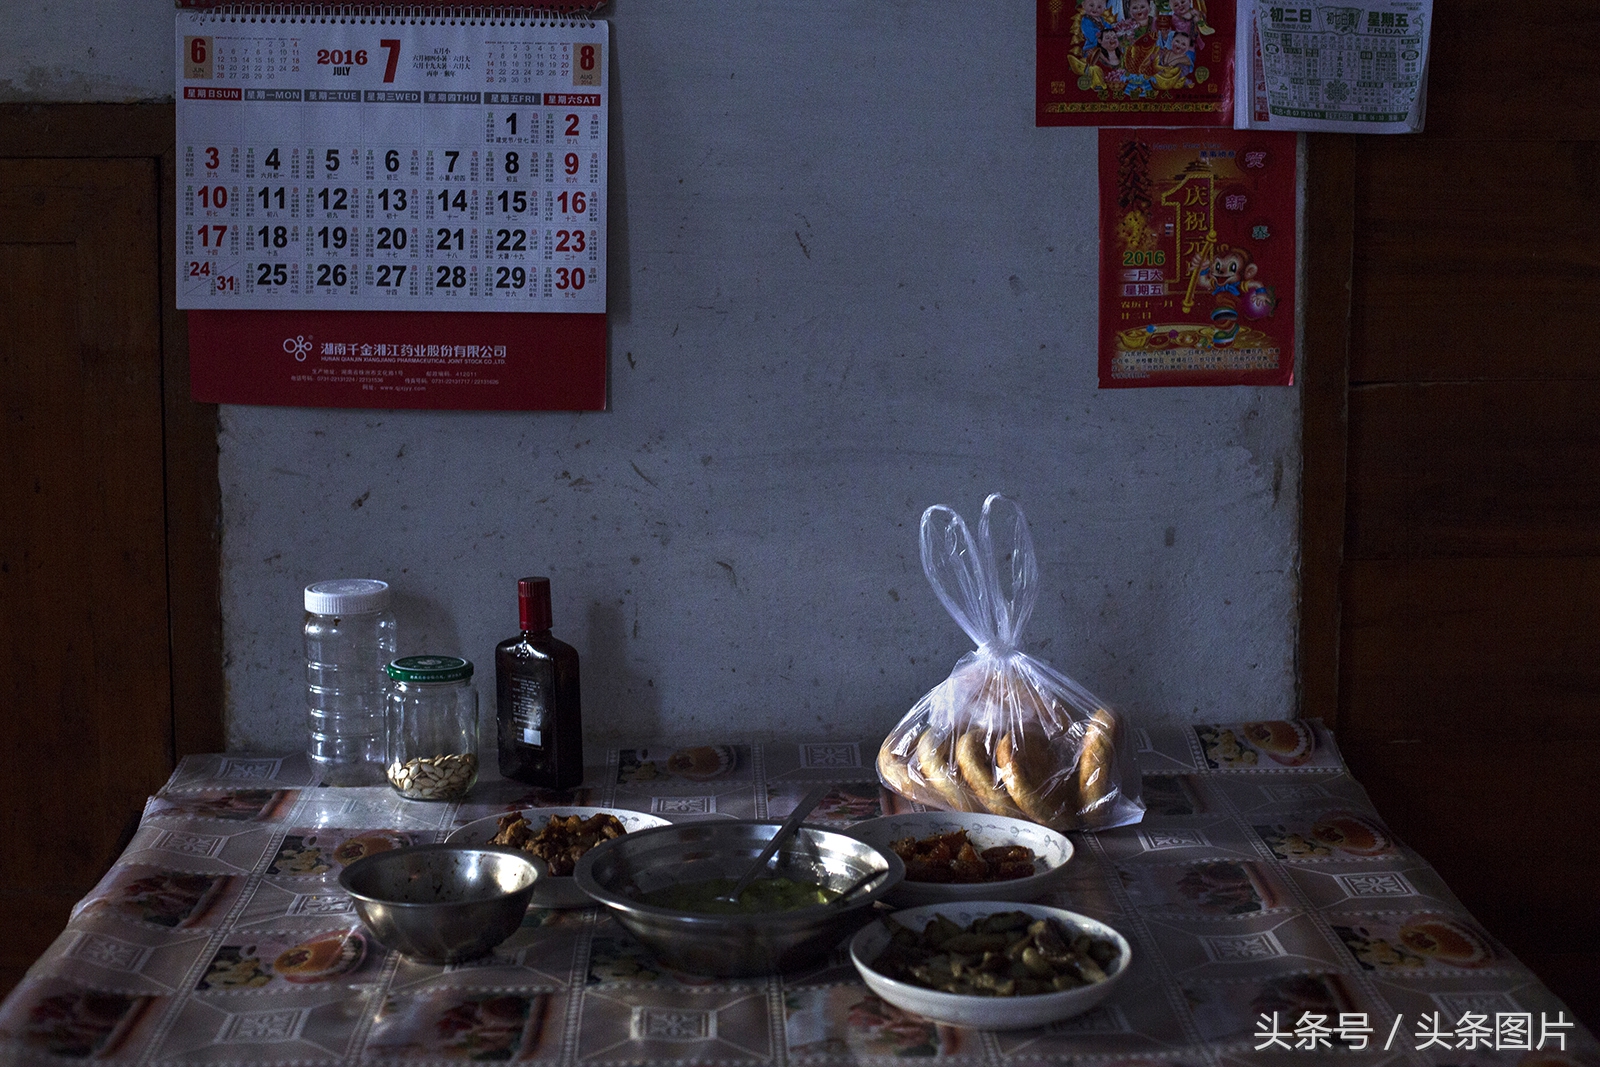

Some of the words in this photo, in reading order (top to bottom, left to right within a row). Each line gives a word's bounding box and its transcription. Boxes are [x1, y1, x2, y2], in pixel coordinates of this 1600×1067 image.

[1270, 7, 1312, 23] 初二日
[1367, 12, 1409, 28] 星期五
[191, 38, 206, 63] 6
[317, 49, 367, 65] 2016
[580, 45, 594, 70] 8
[380, 39, 400, 83] 7
[333, 67, 350, 76] JULY
[188, 88, 240, 98] 星期日SUN
[248, 89, 300, 101] 星期一MON
[310, 92, 356, 100] 星期二TUE
[368, 93, 418, 101] 星期三WED
[429, 93, 477, 101] 星期四THU
[491, 94, 534, 103] 星期五FRI
[549, 95, 596, 104] 星期六SAT
[506, 113, 516, 135] 1
[565, 114, 579, 136] 2
[205, 147, 219, 169] 3
[265, 148, 280, 170] 4
[326, 149, 340, 171] 5
[385, 150, 399, 172] 6
[445, 151, 459, 172] 7
[505, 152, 519, 174] 8
[565, 153, 579, 175] 9
[1245, 151, 1267, 168] 贺
[198, 186, 227, 208] 10
[259, 187, 284, 209] 11
[319, 188, 347, 210] 12
[378, 189, 407, 211] 13
[438, 190, 467, 211] 14
[498, 190, 526, 212] 15
[558, 191, 586, 213] 16
[1225, 194, 1247, 211] 新
[198, 225, 227, 247] 17
[258, 226, 287, 248] 18
[318, 227, 347, 249] 19
[377, 227, 407, 249] 20
[437, 228, 463, 250] 21
[497, 229, 526, 251] 22
[556, 230, 585, 252] 23
[1252, 226, 1270, 240] 春
[1122, 250, 1166, 266] 2016
[190, 262, 210, 276] 24
[257, 263, 287, 285] 25
[317, 264, 347, 286] 26
[377, 265, 406, 287] 27
[437, 266, 466, 288] 28
[496, 267, 525, 289] 29
[556, 268, 585, 290] 30
[1124, 270, 1163, 281] 一月大
[217, 276, 233, 290] 31
[1124, 284, 1163, 295] 星期五
[320, 342, 507, 358] 湖南千金湘江药业股份有限公司
